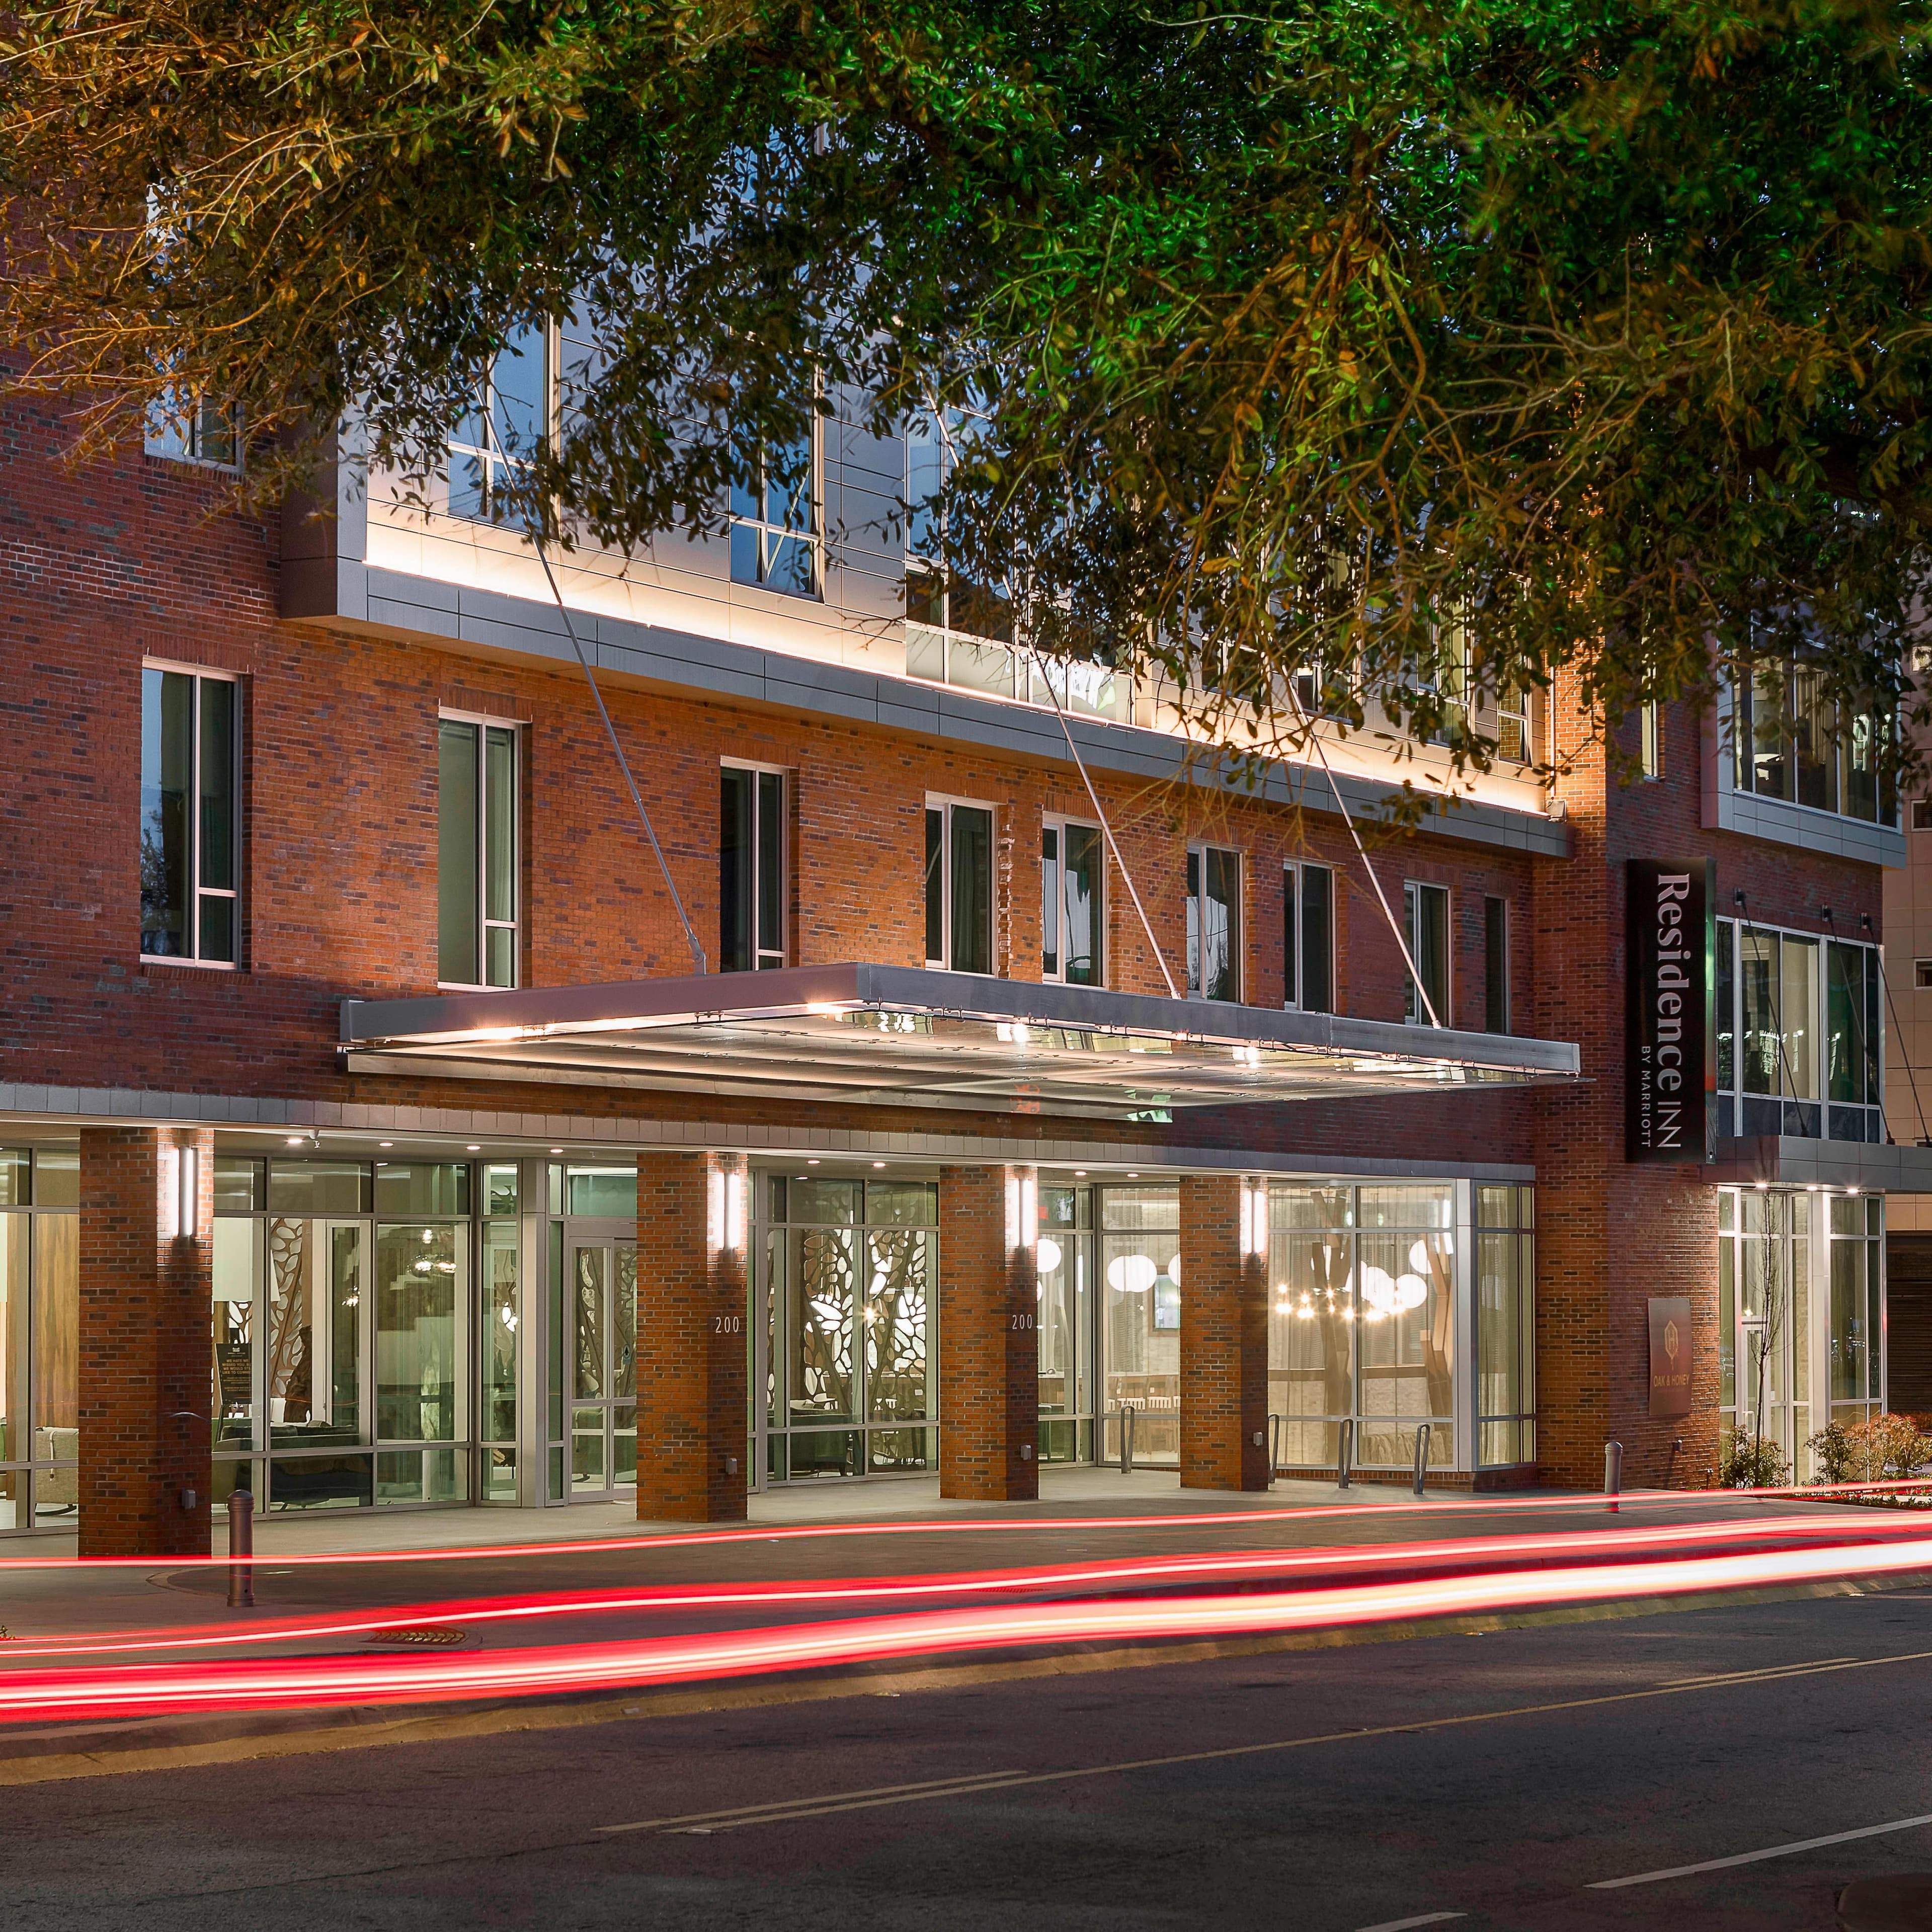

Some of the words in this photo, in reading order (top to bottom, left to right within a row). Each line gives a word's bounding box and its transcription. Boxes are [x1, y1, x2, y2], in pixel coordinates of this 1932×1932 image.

[1657, 873, 1691, 1091] Residence
[1641, 1046, 1651, 1064] BY
[1641, 1070, 1651, 1148] MARRIOTT
[1657, 1101, 1681, 1148] INN
[715, 1317, 739, 1333] 200
[1012, 1314, 1032, 1329] 200
[1653, 1375, 1665, 1387] OAK
[1666, 1375, 1671, 1386] &
[1671, 1374, 1690, 1386] HONEY
